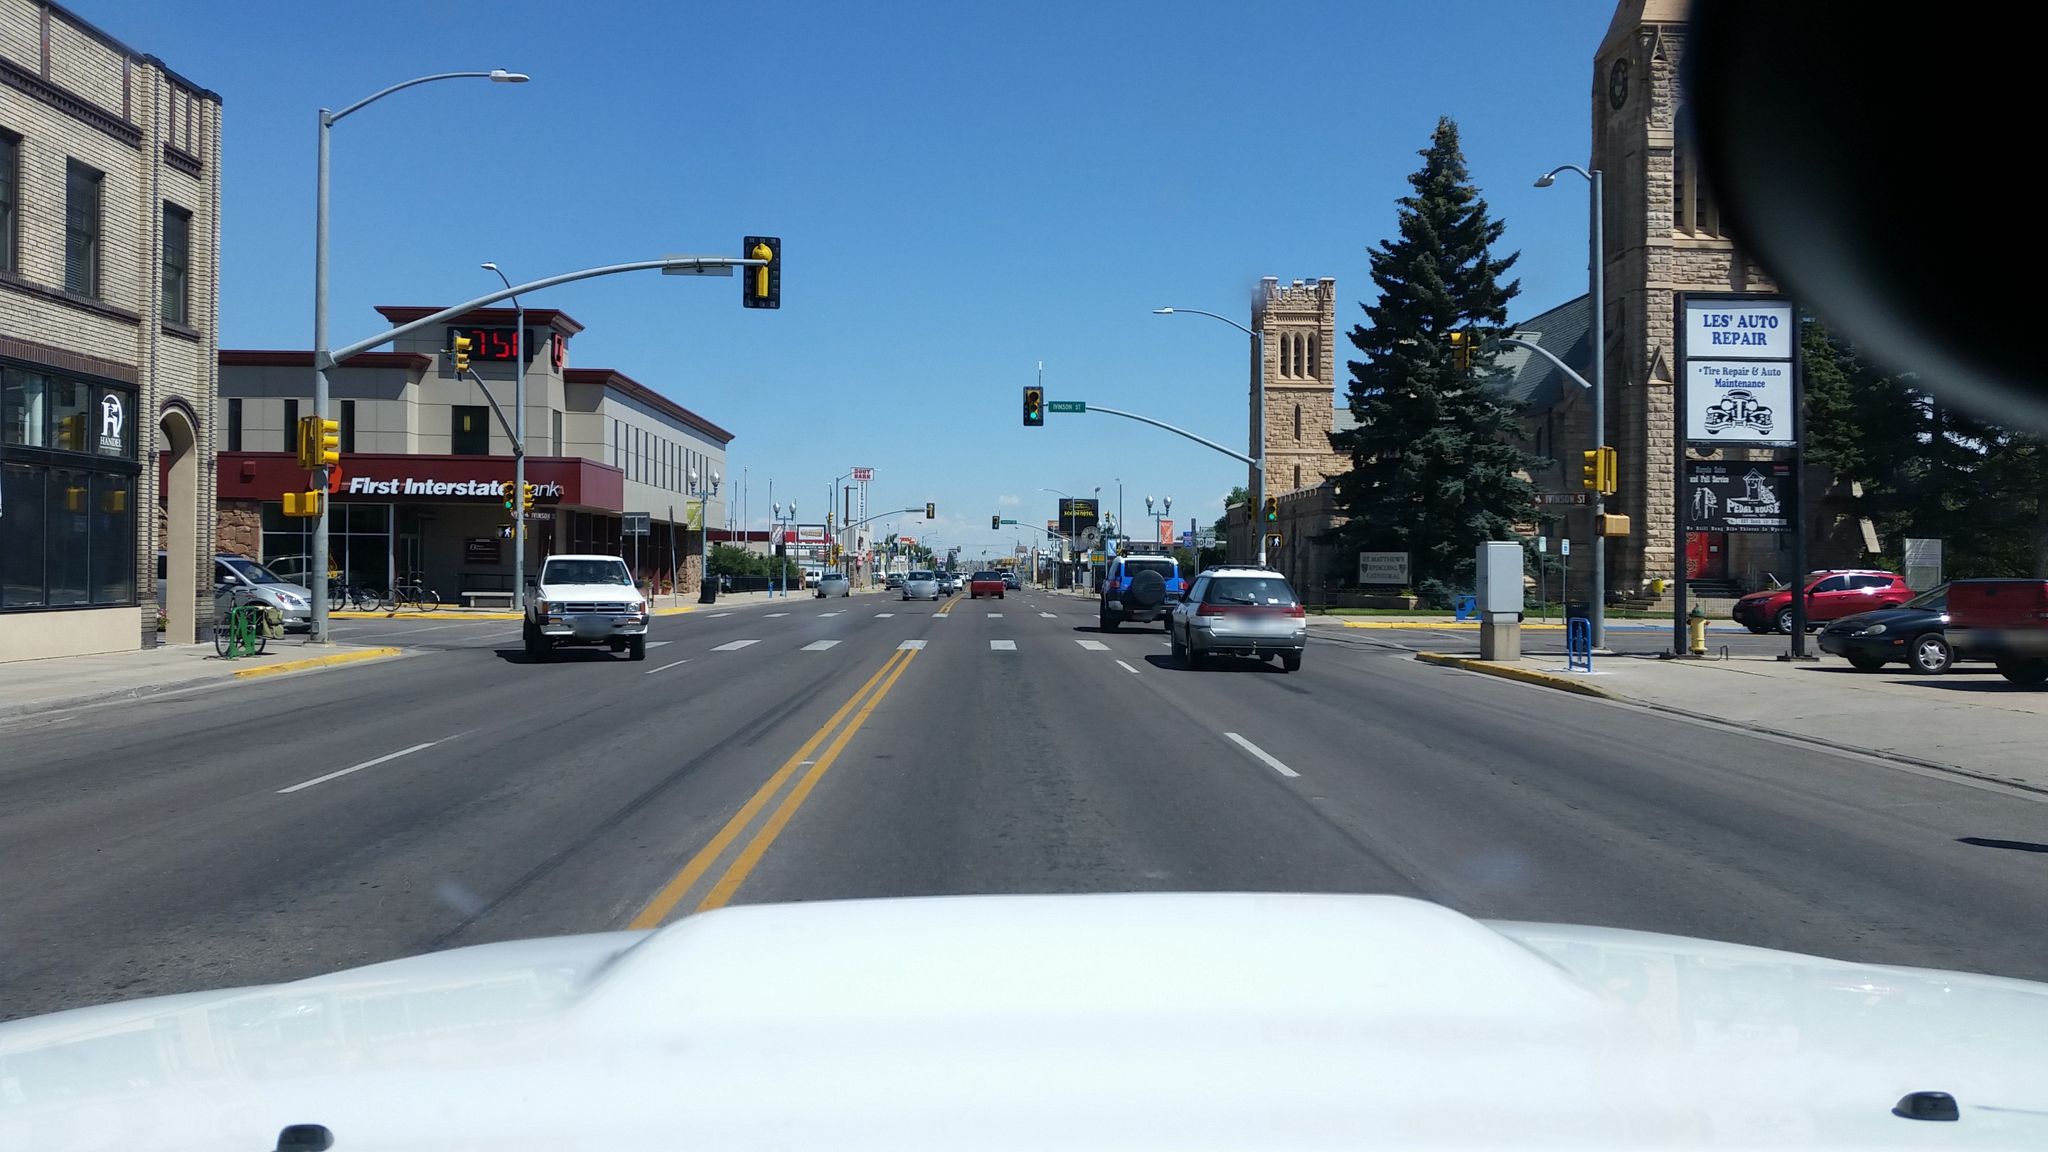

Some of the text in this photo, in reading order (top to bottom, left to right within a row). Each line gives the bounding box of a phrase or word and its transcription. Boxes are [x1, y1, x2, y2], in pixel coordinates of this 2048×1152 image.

[1703, 314, 1779, 329] LES' AUTO
[1712, 331, 1767, 346] REPAIR
[1722, 367, 1750, 378] Repair
[1751, 366, 1759, 376] &
[1761, 367, 1782, 377] Auto
[1714, 378, 1766, 389] Maintenance
[100, 437, 122, 447] HANDEL
[350, 477, 400, 495] First
[523, 480, 560, 497] ank
[1545, 494, 1586, 504] IVINSON ST
[1726, 498, 1781, 514] PEDAL HOUSE
